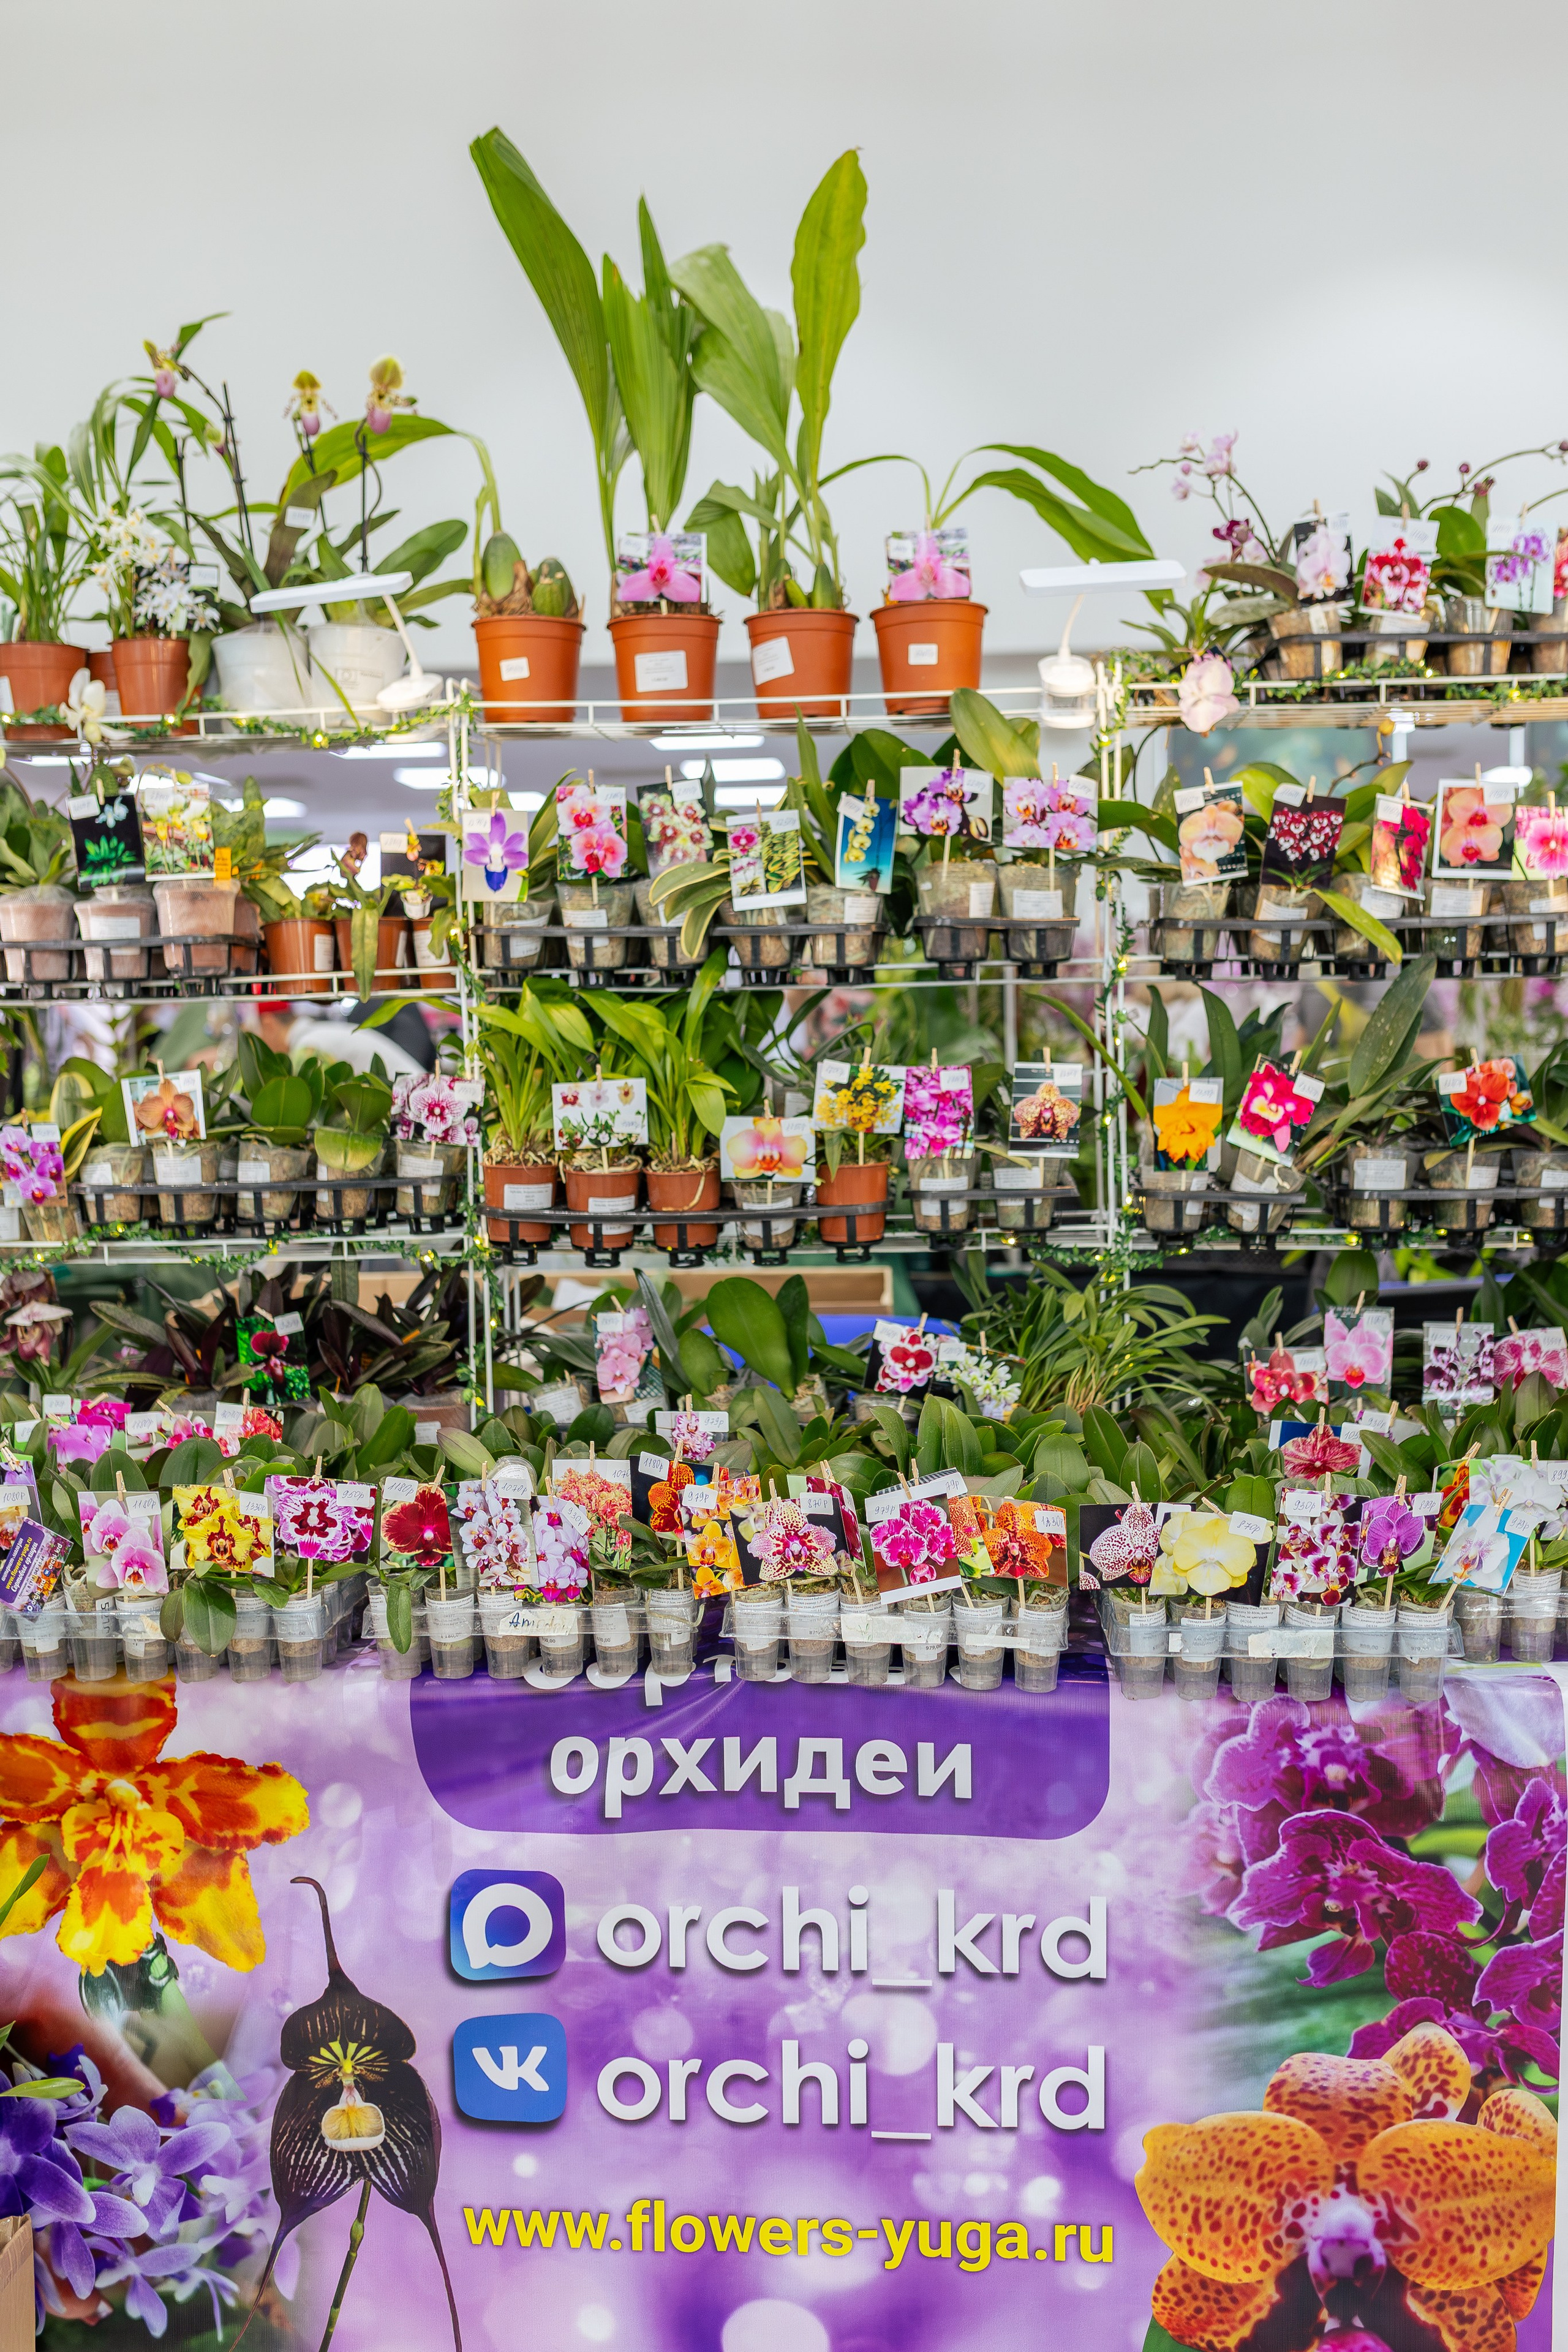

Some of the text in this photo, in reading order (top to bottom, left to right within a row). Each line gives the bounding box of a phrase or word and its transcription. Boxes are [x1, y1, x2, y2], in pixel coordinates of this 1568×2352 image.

[5, 1537, 33, 1589] www.flowers-yuga.ru
[550, 1735, 971, 1818] орхидеи
[597, 1885, 1107, 1986] orchi_krd
[597, 2038, 1104, 2139] orchi_krd
[463, 2198, 1114, 2272] www.flowers-yuga.ru
